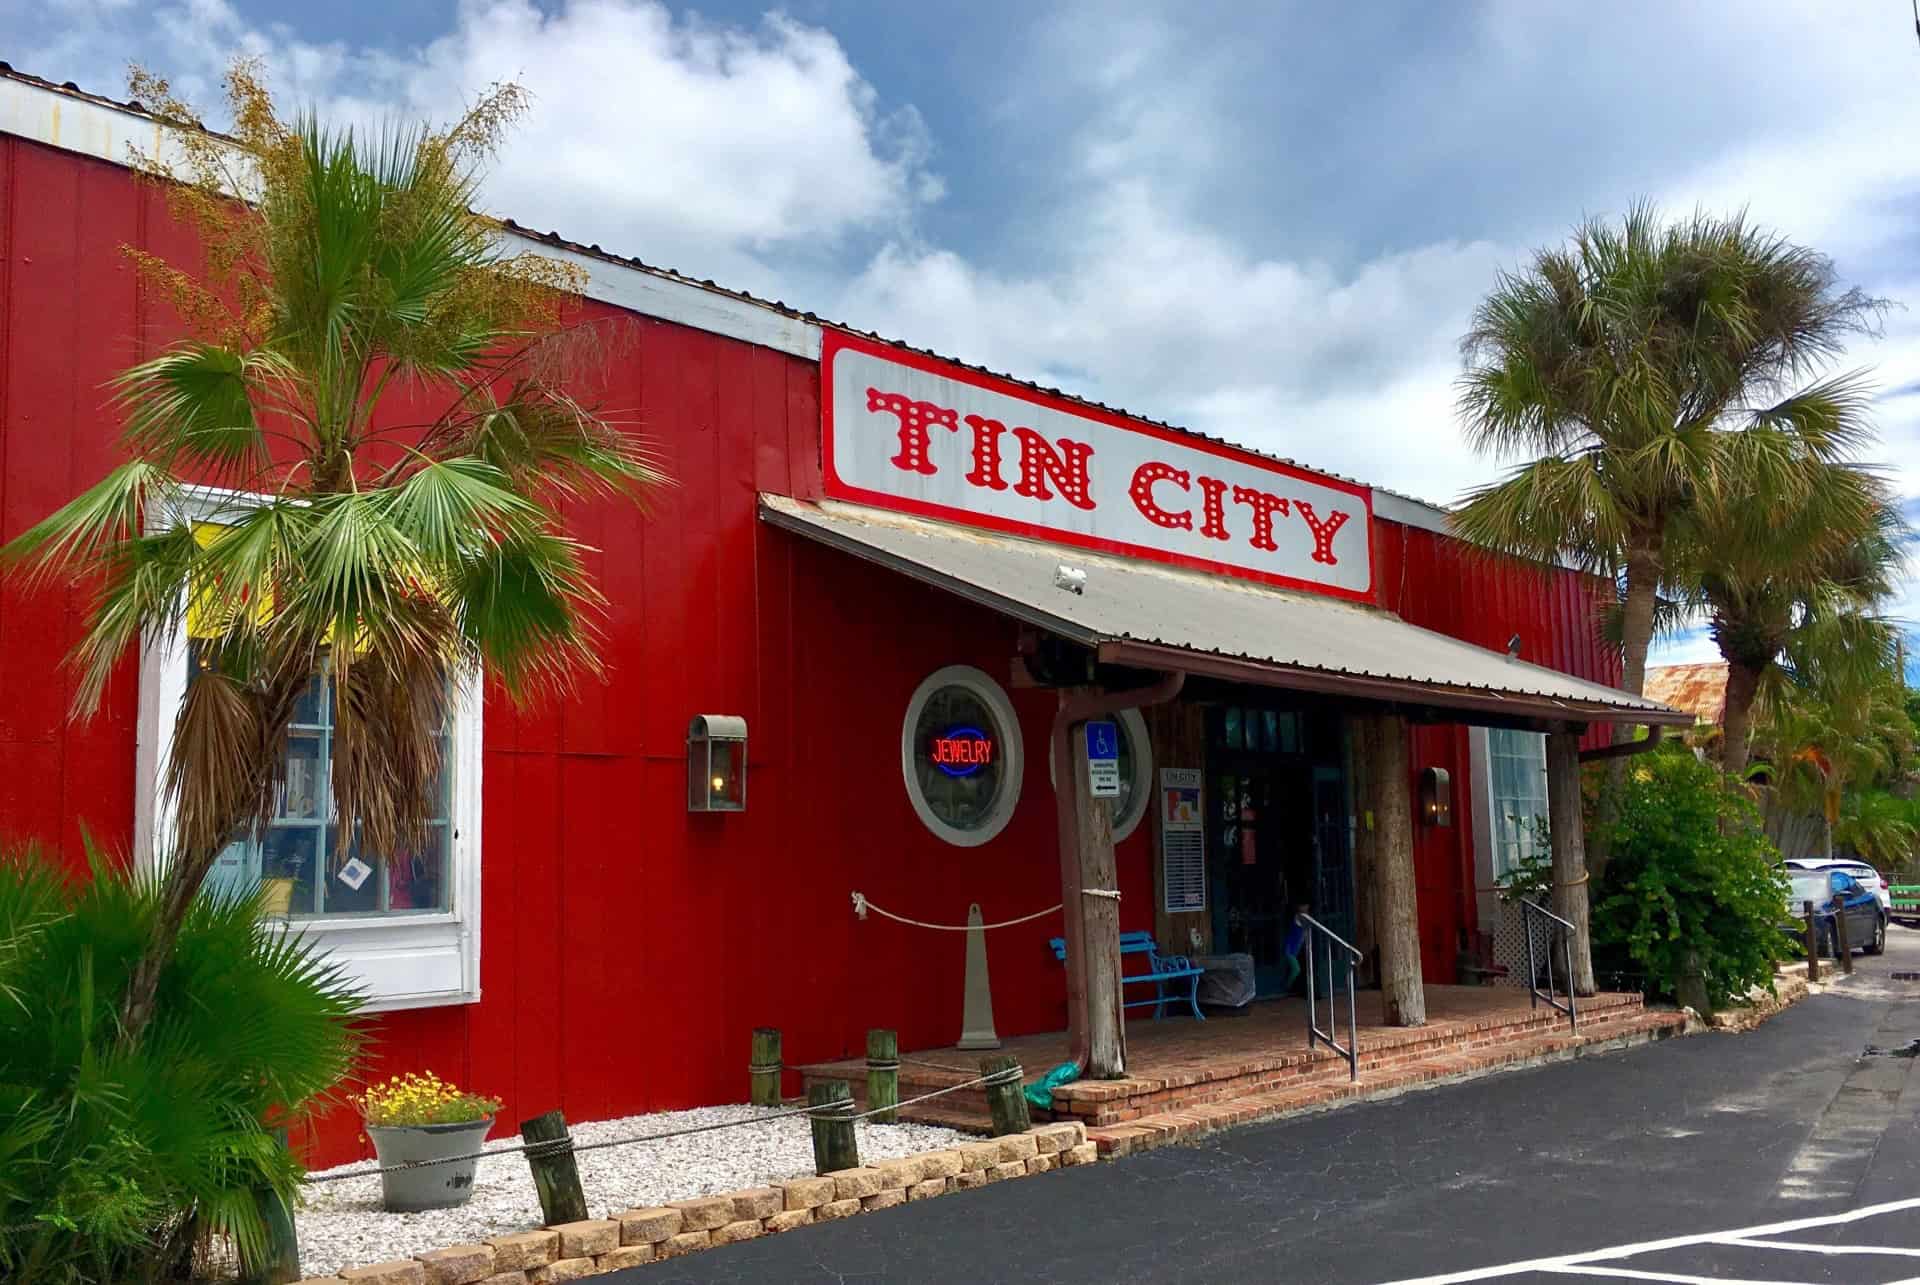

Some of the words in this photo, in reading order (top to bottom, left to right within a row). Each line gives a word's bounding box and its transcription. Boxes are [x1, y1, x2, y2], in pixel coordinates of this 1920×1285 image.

[866, 387, 1096, 511] TIN
[1129, 461, 1350, 566] CITY
[932, 739, 992, 764] JEWELRY
